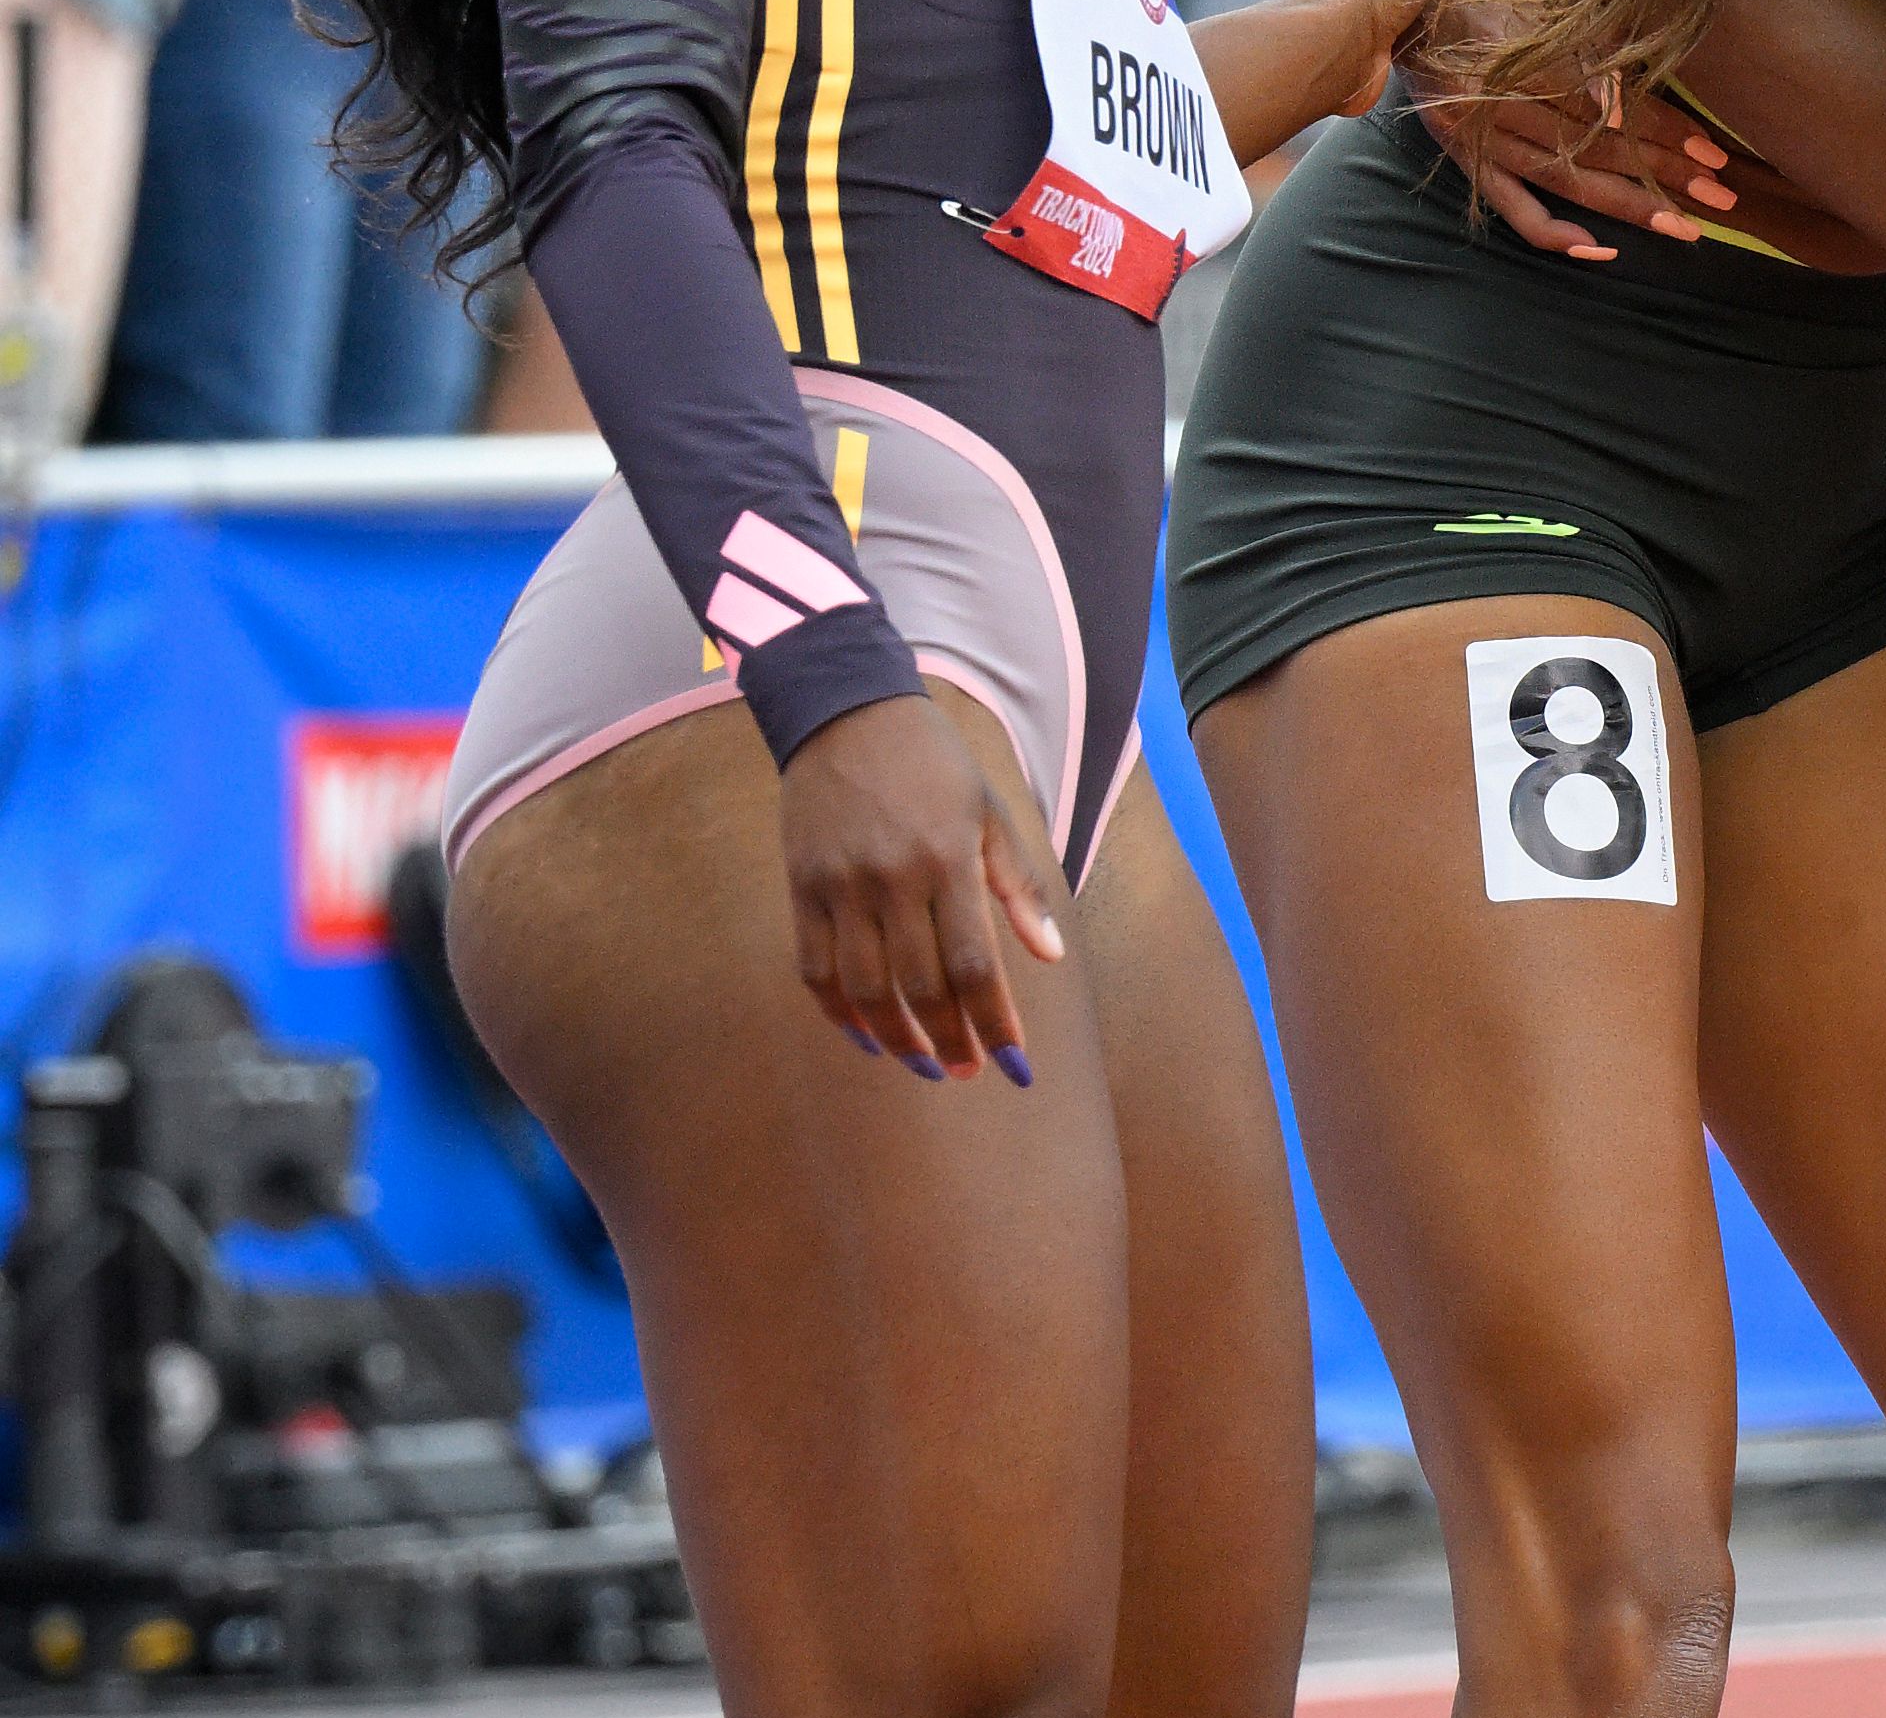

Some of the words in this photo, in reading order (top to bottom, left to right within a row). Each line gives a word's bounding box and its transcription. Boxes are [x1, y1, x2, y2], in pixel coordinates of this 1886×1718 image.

[1091, 39, 1211, 196] BROWN
[1030, 184, 1125, 252] TRACKTOWN
[1070, 234, 1117, 280] 2024
[1508, 656, 1647, 881] 8
